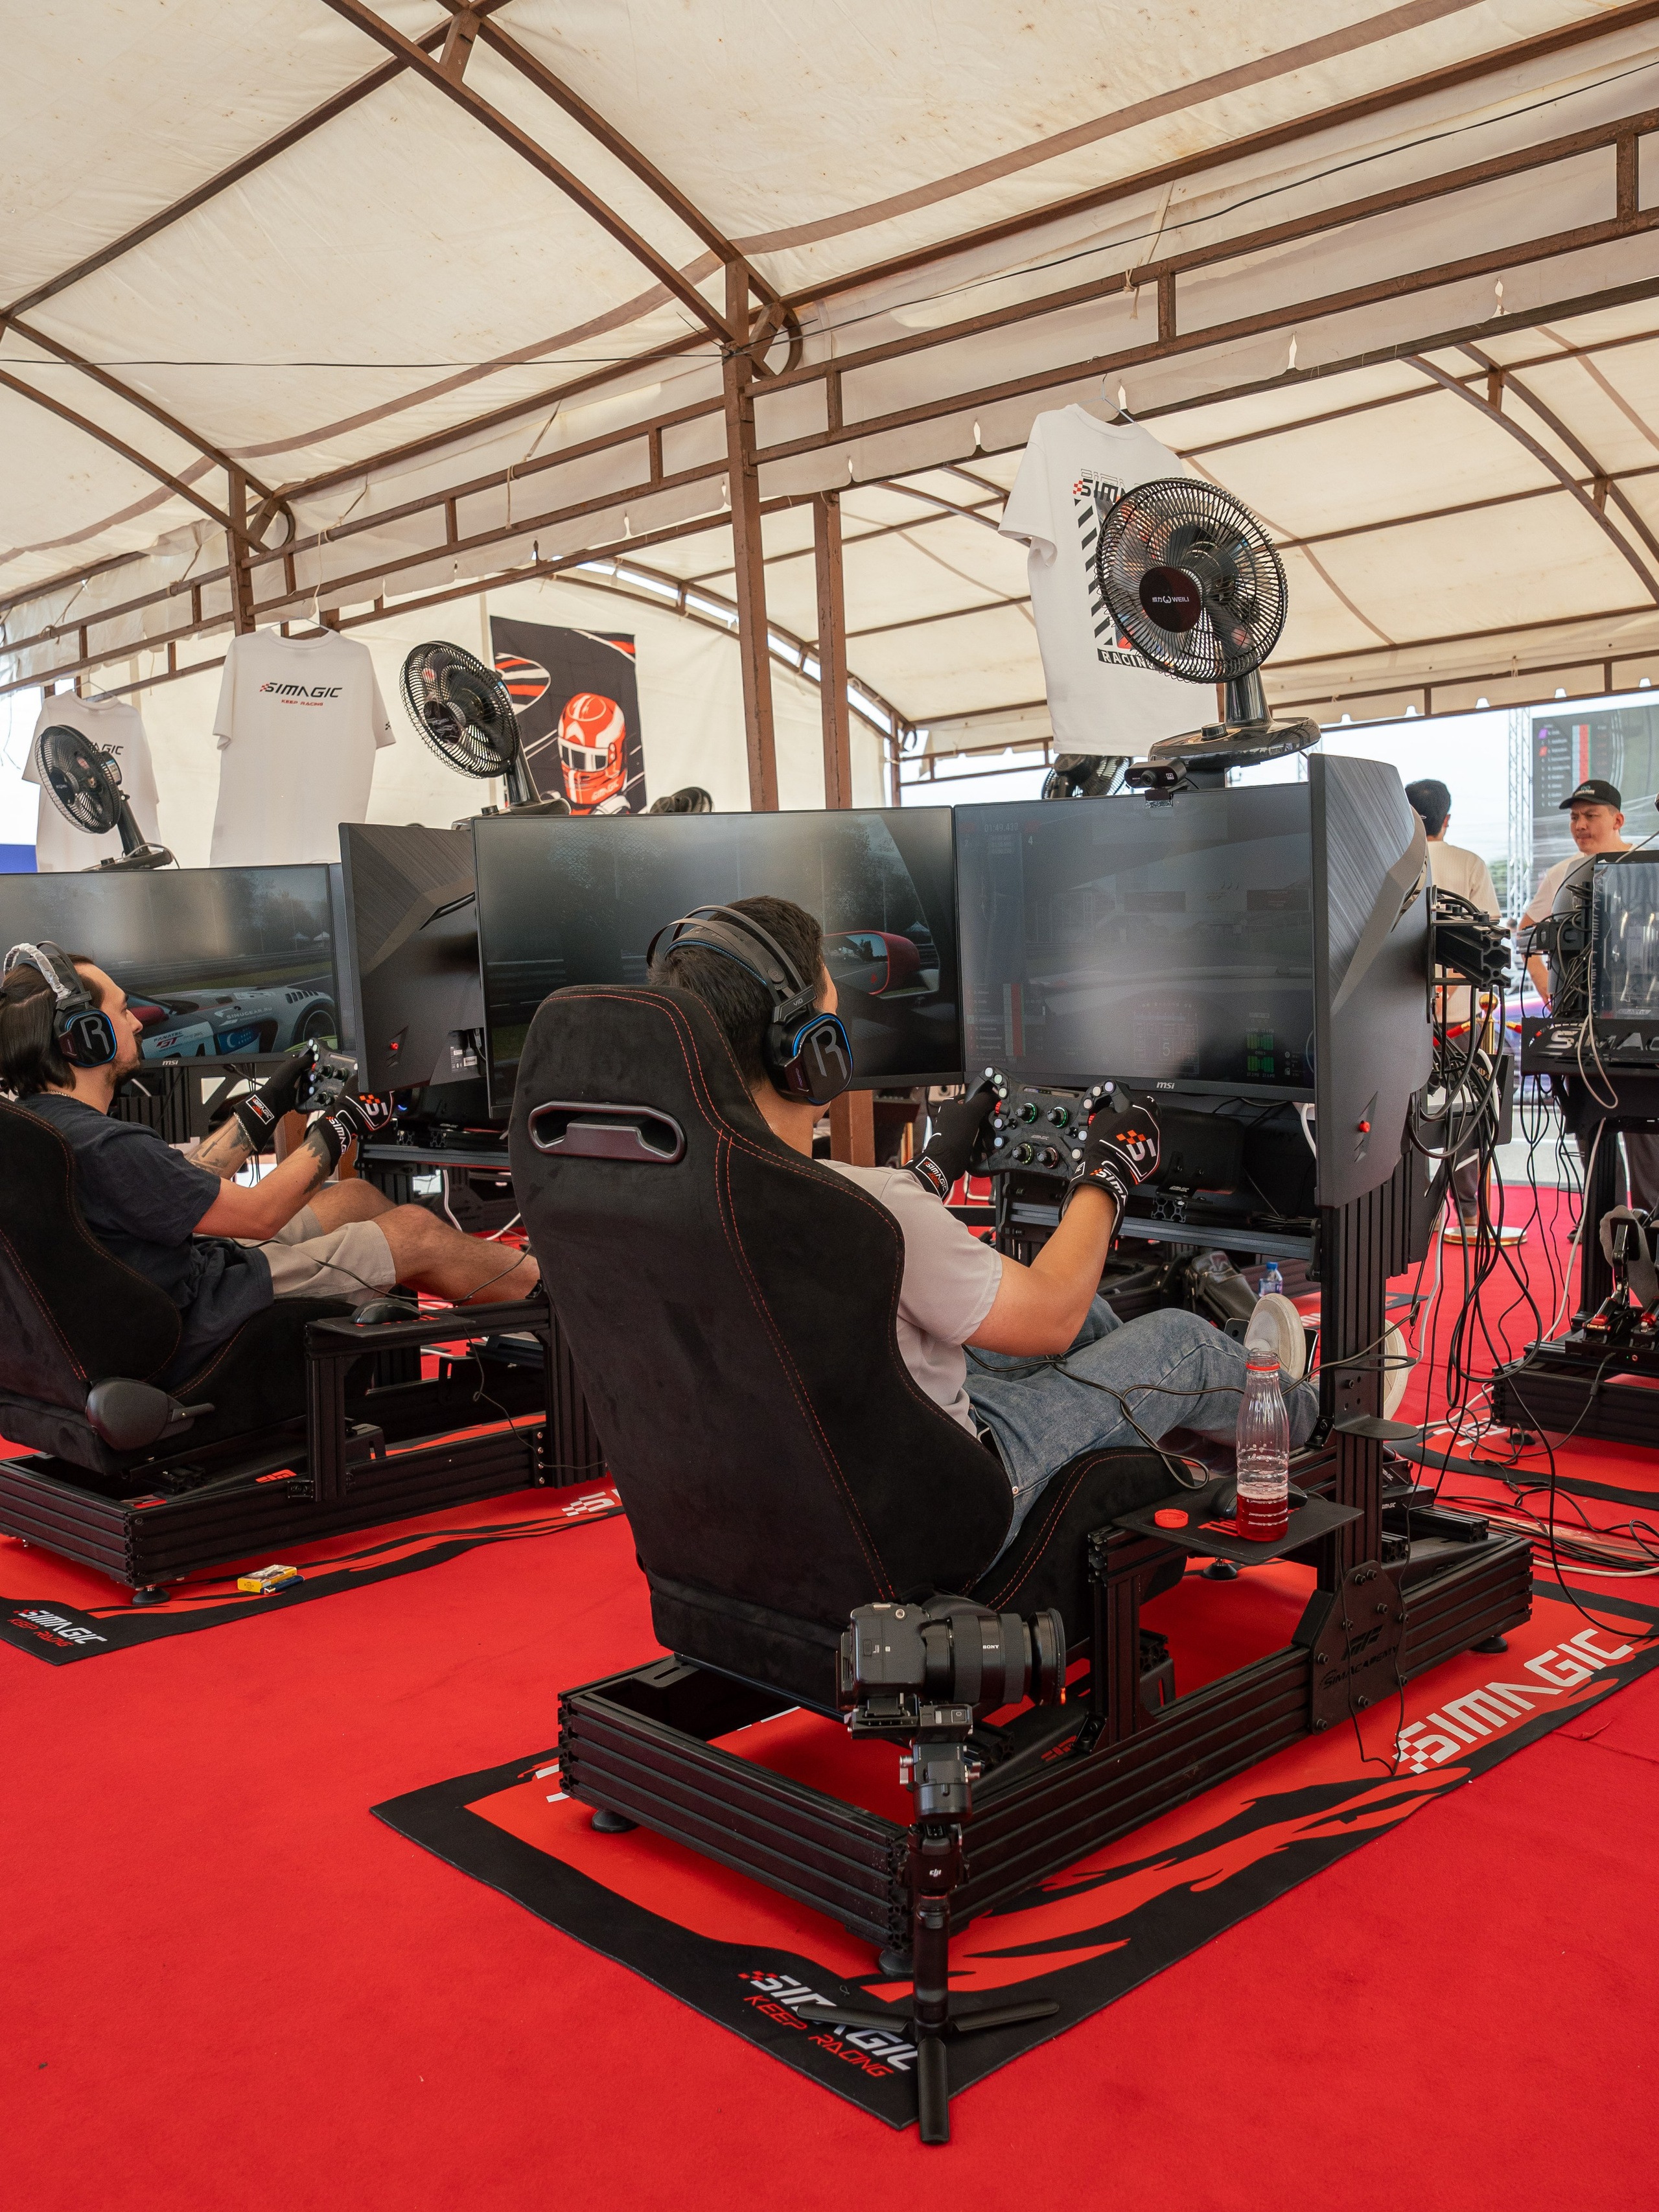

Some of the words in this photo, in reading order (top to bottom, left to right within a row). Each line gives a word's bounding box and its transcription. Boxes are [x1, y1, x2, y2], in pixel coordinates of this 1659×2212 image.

[260, 682, 343, 698] SIMAGIC
[326, 1116, 347, 1154] SIMAG
[923, 1161, 947, 1191] SIMAGIC
[7, 1618, 39, 1629] KEEP
[13, 1609, 108, 1644] SIMAGIC
[1392, 1628, 1634, 1774] SIMAGIC
[738, 1971, 918, 2071] SIMGIC
[744, 1995, 808, 2031] KEEP
[807, 2034, 894, 2078] RACING
